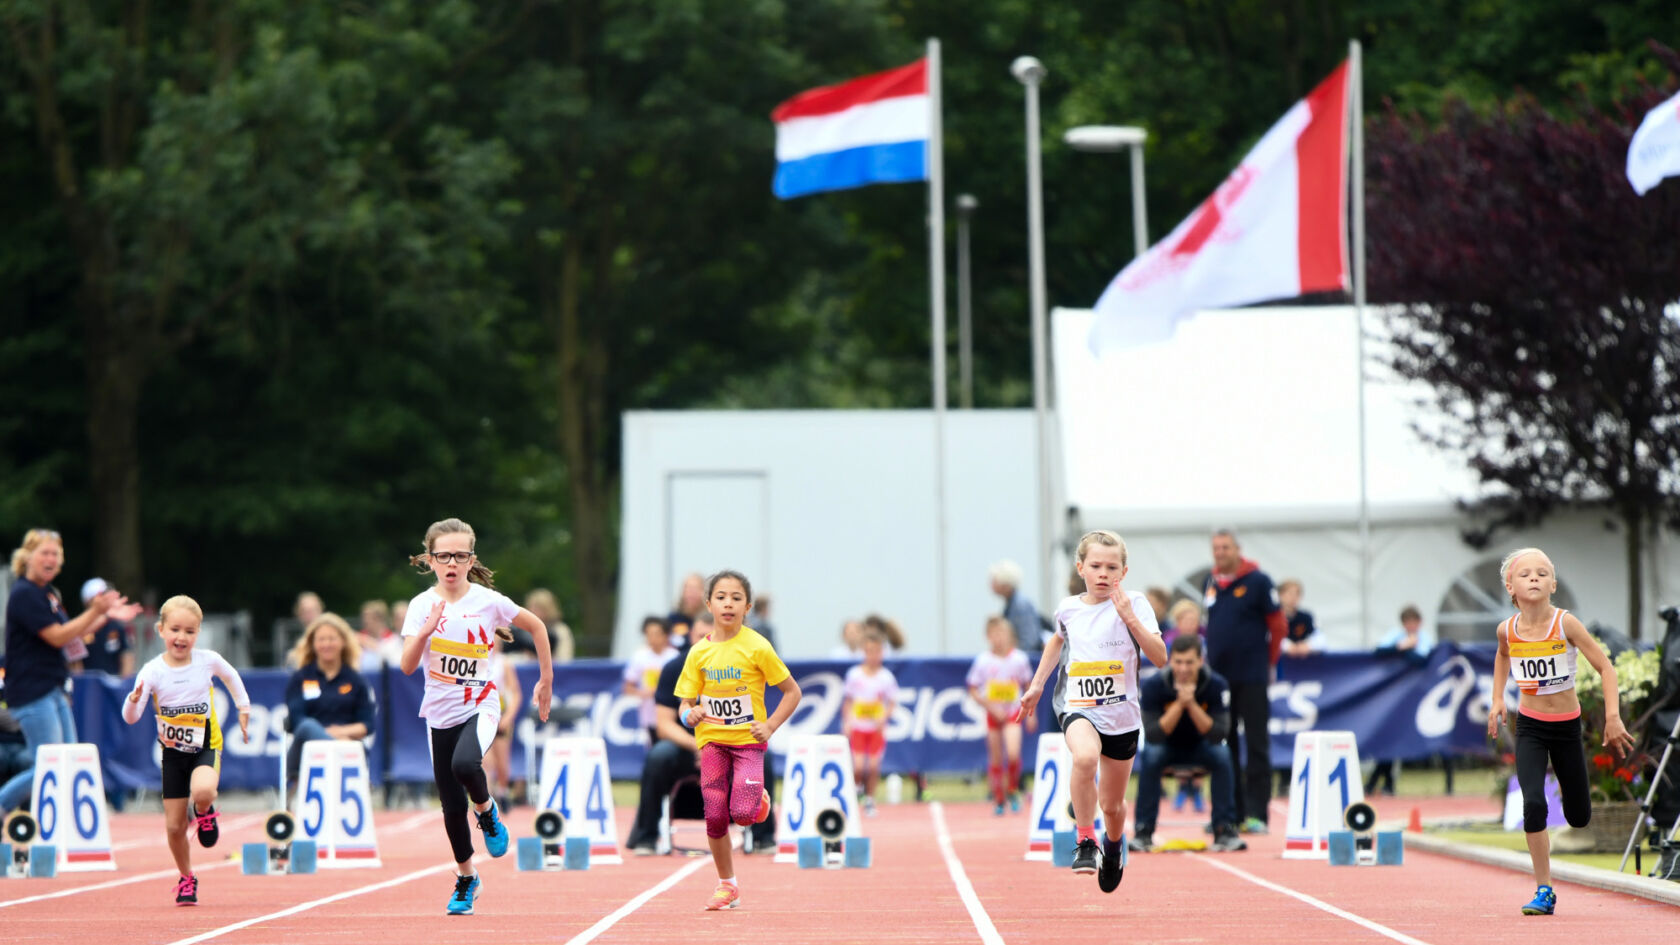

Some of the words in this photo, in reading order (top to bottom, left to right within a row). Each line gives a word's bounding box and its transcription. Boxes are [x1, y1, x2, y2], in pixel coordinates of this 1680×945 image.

[440, 656, 478, 678] 1004
[1077, 676, 1115, 698] 1002
[1520, 657, 1557, 679] 1001
[162, 723, 194, 744] 1005
[708, 698, 743, 718] 1003
[38, 769, 58, 841] 6
[72, 769, 99, 841] 6
[303, 767, 325, 838] 5
[340, 767, 364, 838] 5
[546, 763, 571, 821] 4
[585, 763, 609, 835] 4
[787, 761, 806, 832] 3
[820, 761, 849, 819] 3
[1038, 759, 1059, 830] 2
[1298, 757, 1311, 829] 1
[1328, 757, 1350, 829] 1
